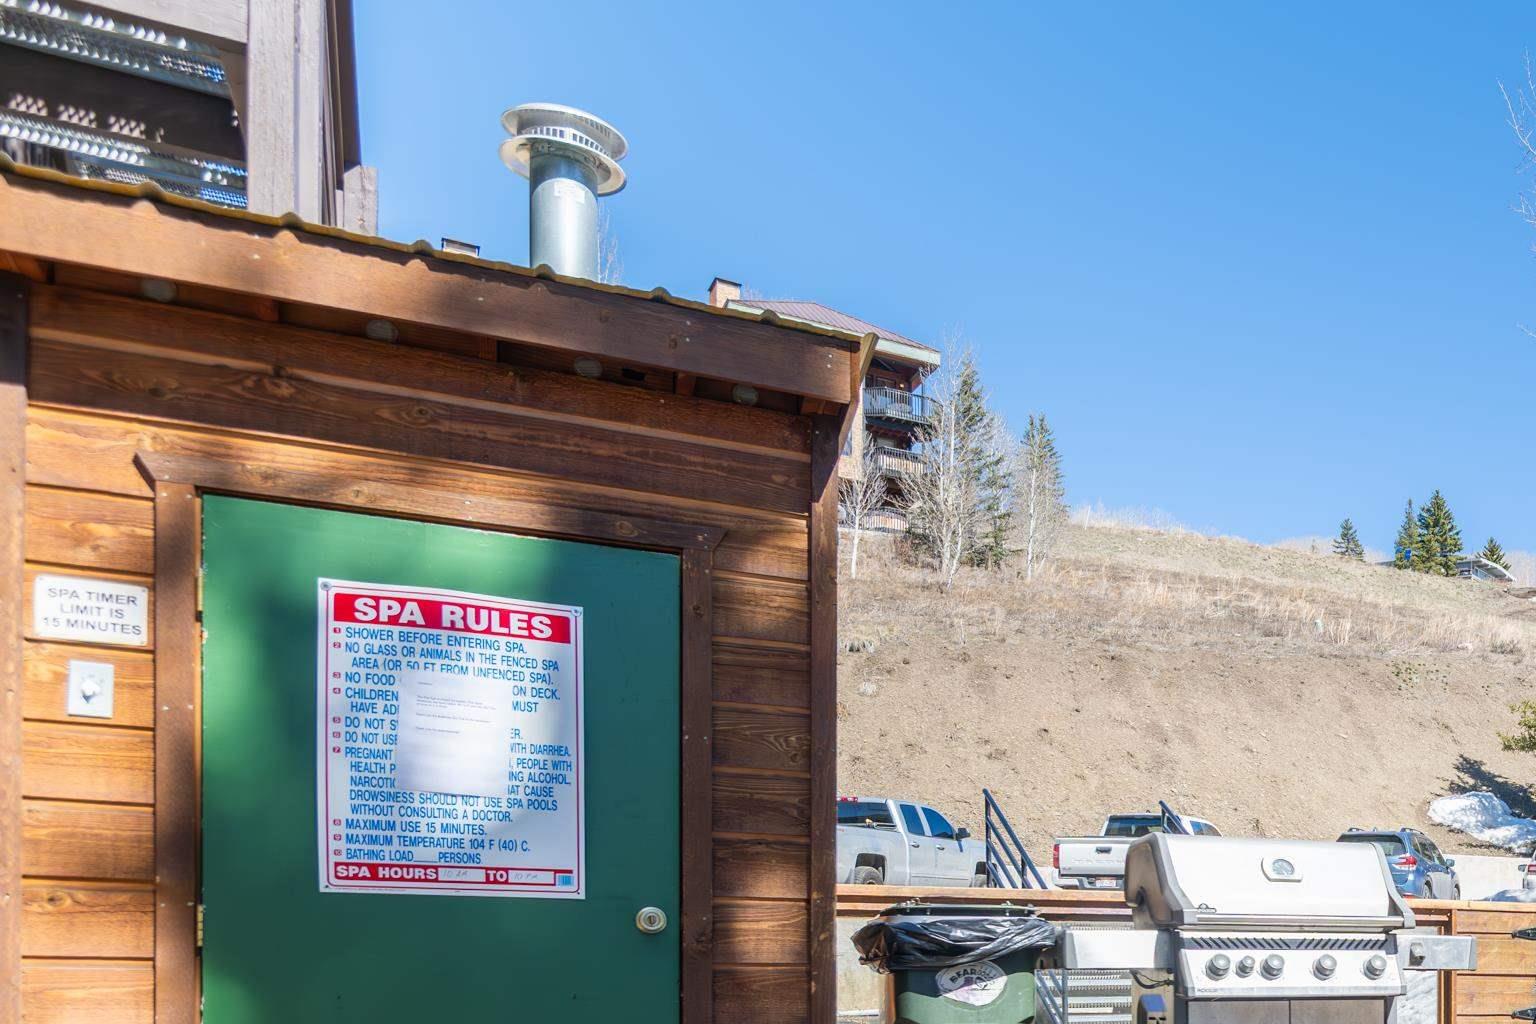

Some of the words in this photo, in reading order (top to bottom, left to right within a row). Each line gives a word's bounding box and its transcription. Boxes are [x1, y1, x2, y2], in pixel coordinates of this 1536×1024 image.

[47, 587, 80, 599] SPA
[86, 591, 139, 607] TIMER
[60, 603, 104, 617] LIMIT
[109, 609, 125, 620] IS
[353, 597, 426, 626] SPA
[441, 604, 553, 639] RULES
[43, 616, 61, 628] 15
[66, 618, 142, 636] MINUTES
[345, 627, 393, 641] SHOWER
[398, 631, 442, 645] BEFORE
[447, 634, 500, 651] ENTERING
[505, 641, 528, 654] SPA.
[345, 642, 360, 654] NO
[364, 643, 398, 657] GLASS
[401, 646, 416, 658] OR
[419, 647, 462, 662] ANIMALS
[466, 652, 475, 663] IN
[479, 653, 497, 665] THE
[501, 655, 538, 669] FENCED
[542, 660, 560, 672] SPA
[352, 657, 380, 669] AREA
[383, 658, 402, 671] (OR
[406, 661, 420, 670] 50
[423, 663, 436, 672] FT
[440, 664, 468, 676] FROM
[473, 666, 526, 682] UNFENCED
[529, 672, 554, 686] SPA).
[345, 672, 361, 684] NO
[365, 673, 396, 686] FOOD
[512, 685, 527, 696] ON
[531, 687, 561, 700] DECK.
[345, 687, 399, 702] CHILDREN
[512, 700, 539, 713] MUST
[350, 702, 378, 714] HAVE
[383, 703, 399, 715] AD
[345, 716, 360, 728] DO
[364, 718, 386, 730] NOT
[345, 731, 358, 743] DO
[361, 733, 379, 744] NOT
[530, 744, 571, 757] DIARRHEA.
[345, 746, 393, 760] PREGNANT
[516, 758, 548, 770] PEOPLE
[551, 760, 572, 772] WITH
[350, 761, 386, 773] HEALTH
[508, 771, 524, 782] ING
[350, 789, 415, 804] DROWSINESS
[418, 793, 457, 806] SHOULD
[461, 795, 480, 807] NOT
[484, 796, 503, 808] USE
[506, 798, 523, 809] SPA
[527, 798, 558, 811] POOLS
[524, 785, 554, 798] CAUSE
[350, 804, 394, 816] WITHOUT
[398, 805, 458, 820] CONSULTING
[462, 810, 468, 820] A
[472, 810, 513, 822] DOCTOR.
[345, 818, 396, 832] MAXIMUM
[400, 821, 421, 833] USE
[426, 822, 437, 833] 15
[440, 822, 487, 836] MINUTES.
[345, 833, 393, 846] MAXIMUM
[397, 835, 465, 849] TEMPERATURE
[469, 839, 485, 850] 104
[489, 839, 495, 850] F
[498, 839, 517, 852] (40)
[521, 840, 531, 852] C.
[346, 848, 386, 861] BATHING
[389, 850, 414, 862] LOAD
[438, 851, 482, 864] PERSONS
[336, 865, 371, 878] SPA
[377, 866, 437, 880] HOURS
[487, 870, 508, 882] TO
